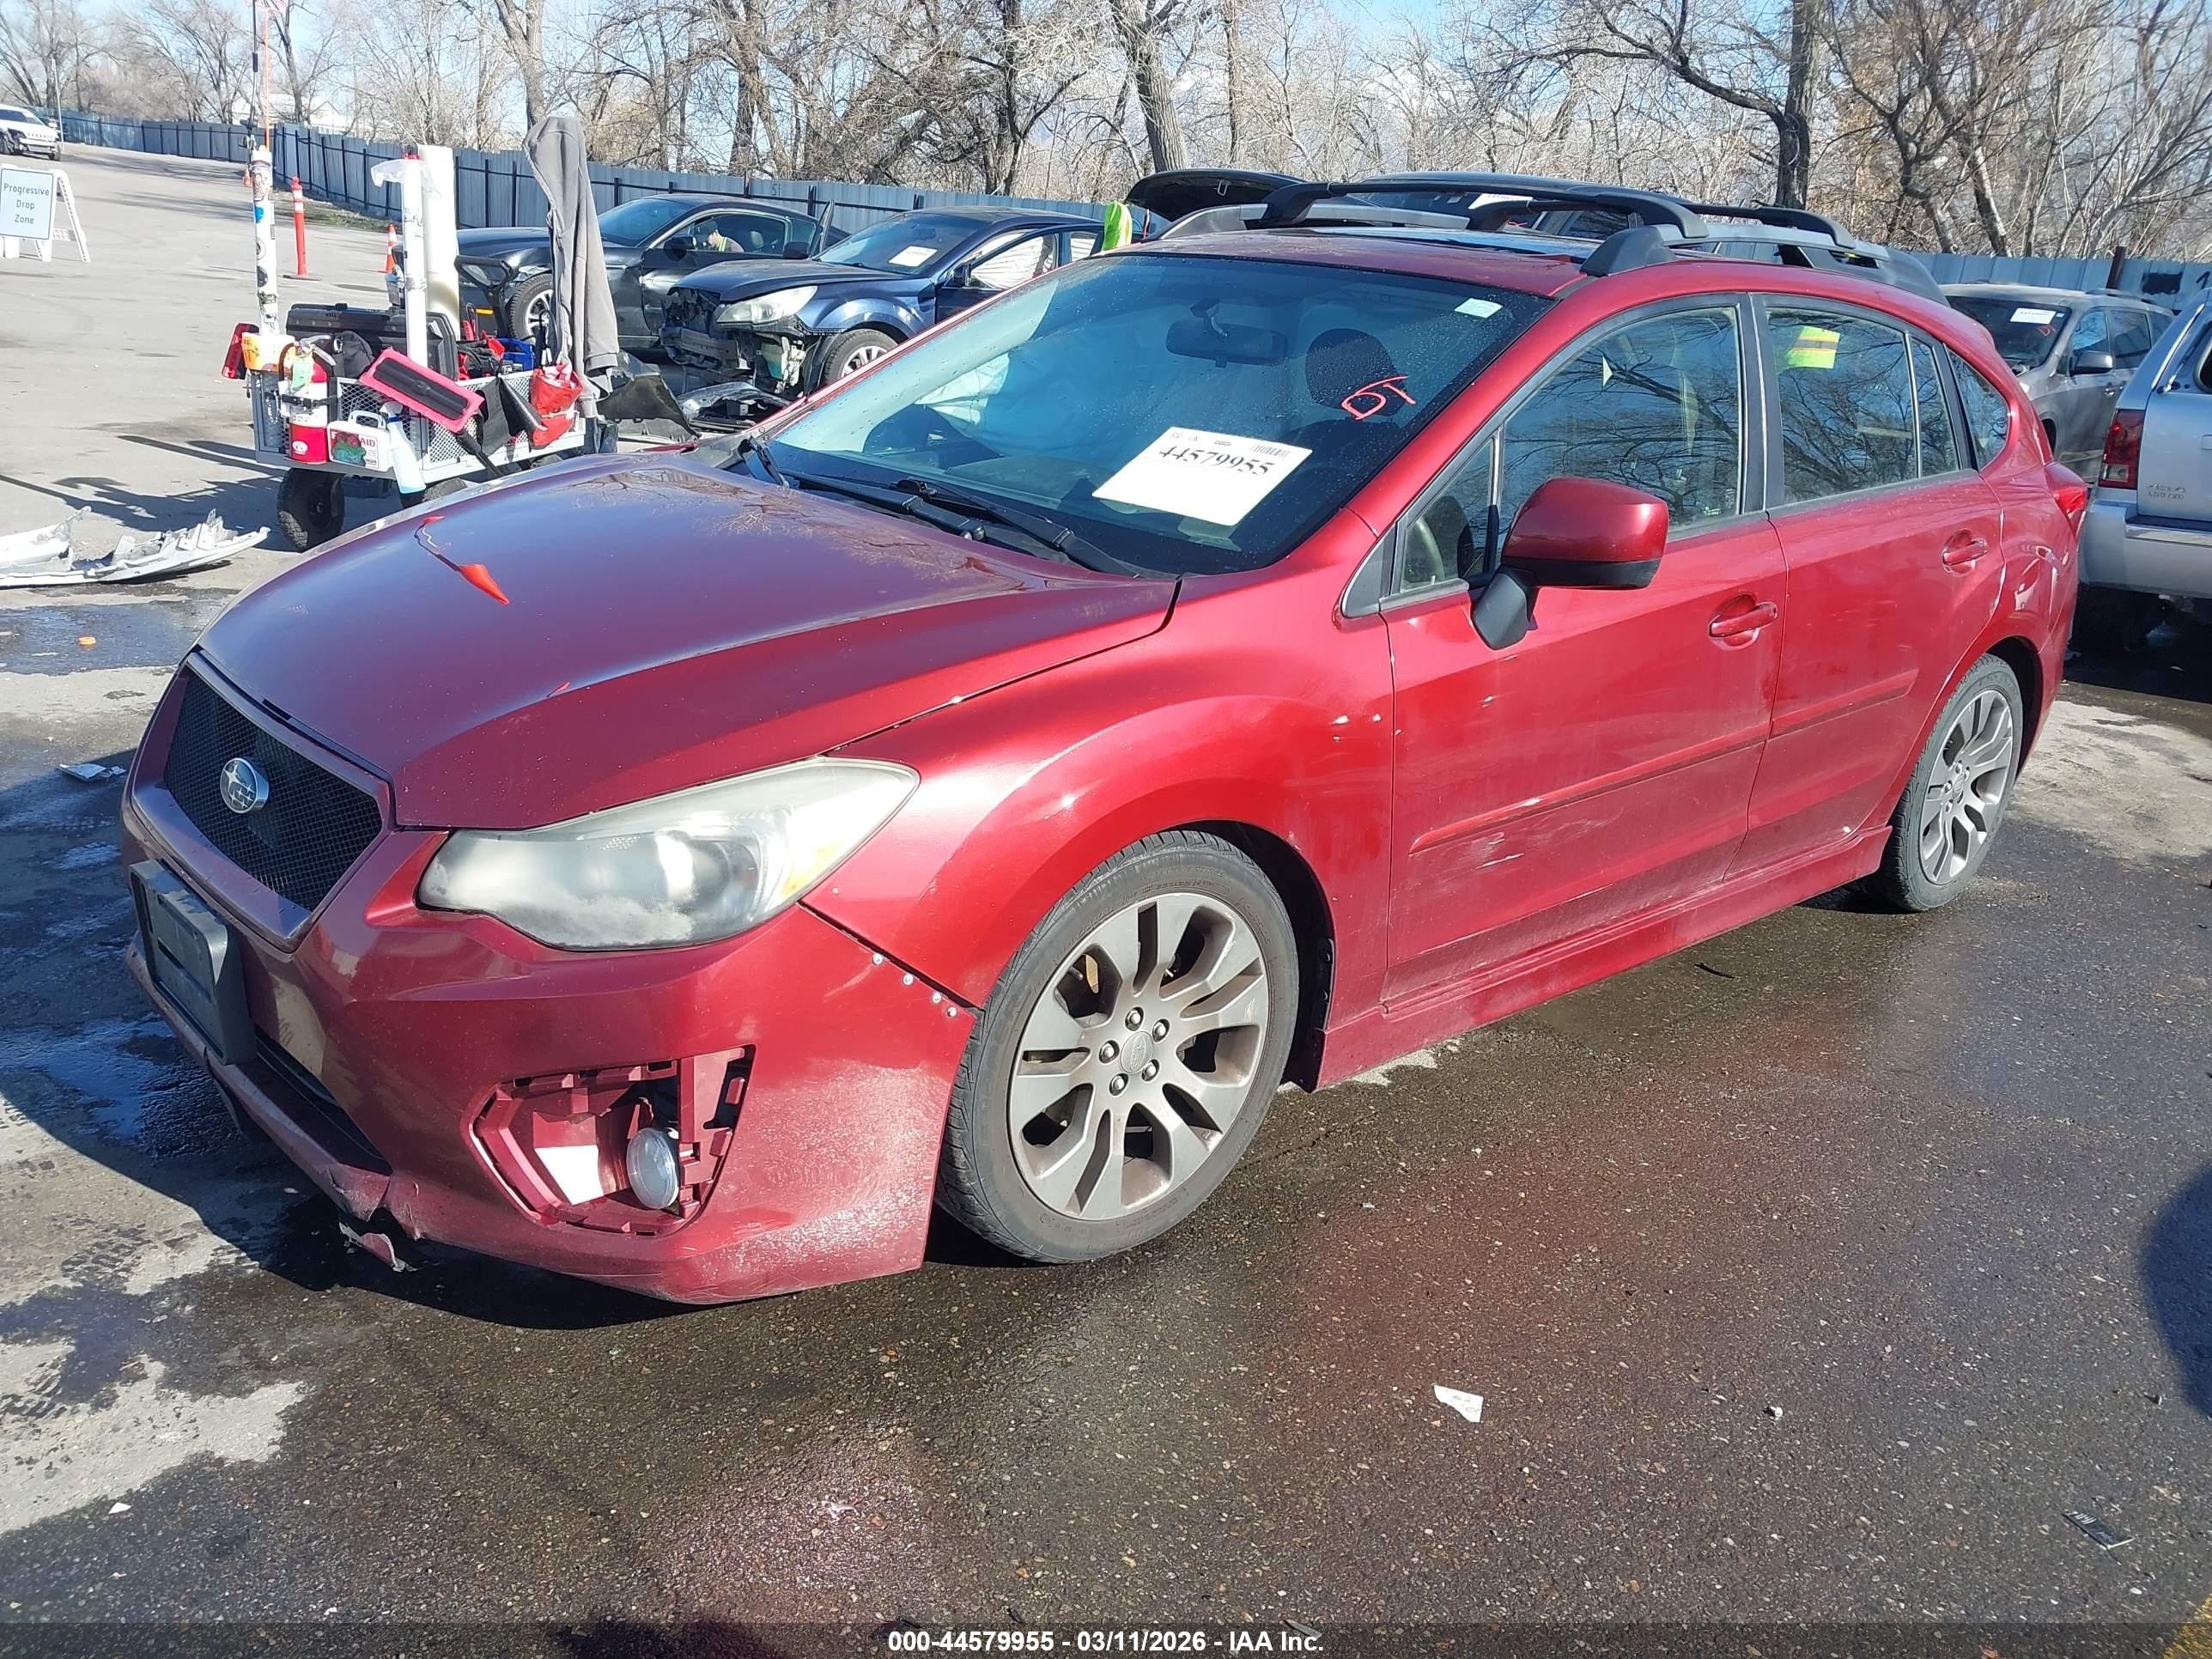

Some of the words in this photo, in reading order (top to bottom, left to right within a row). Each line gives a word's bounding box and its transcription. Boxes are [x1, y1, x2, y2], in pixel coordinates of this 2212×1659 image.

[3, 182, 50, 196] Progressive
[16, 199, 35, 210] Drop
[15, 214, 35, 224] Zone
[1159, 446, 1275, 475] 44579955
